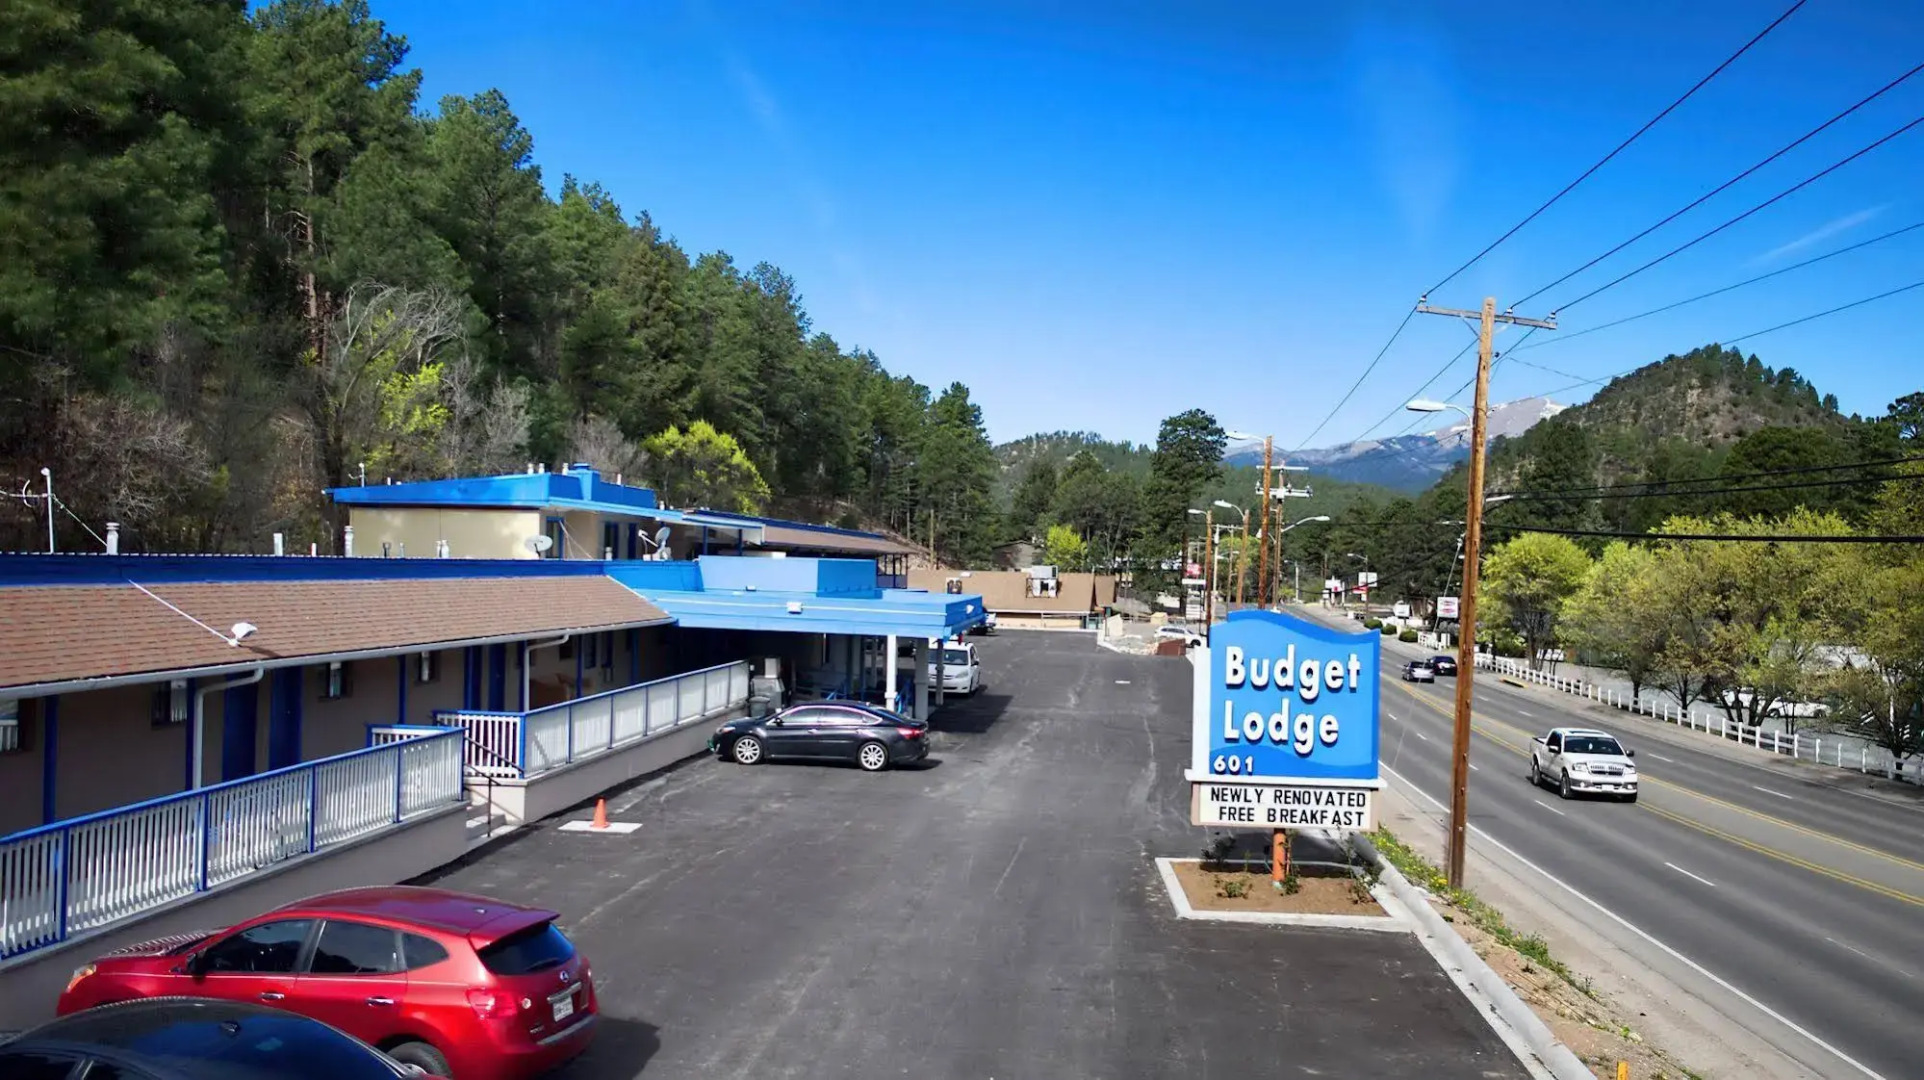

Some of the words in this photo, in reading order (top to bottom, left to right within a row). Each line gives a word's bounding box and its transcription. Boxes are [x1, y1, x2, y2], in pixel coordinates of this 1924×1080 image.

[1225, 643, 1361, 701] Budget
[1223, 697, 1340, 756] Lodge
[1213, 755, 1254, 773] 601
[1210, 787, 1264, 804] NEWLY
[1273, 789, 1366, 808] RENOVATED
[1218, 806, 1255, 822] FREE
[1266, 808, 1364, 827] BREAKFAST
